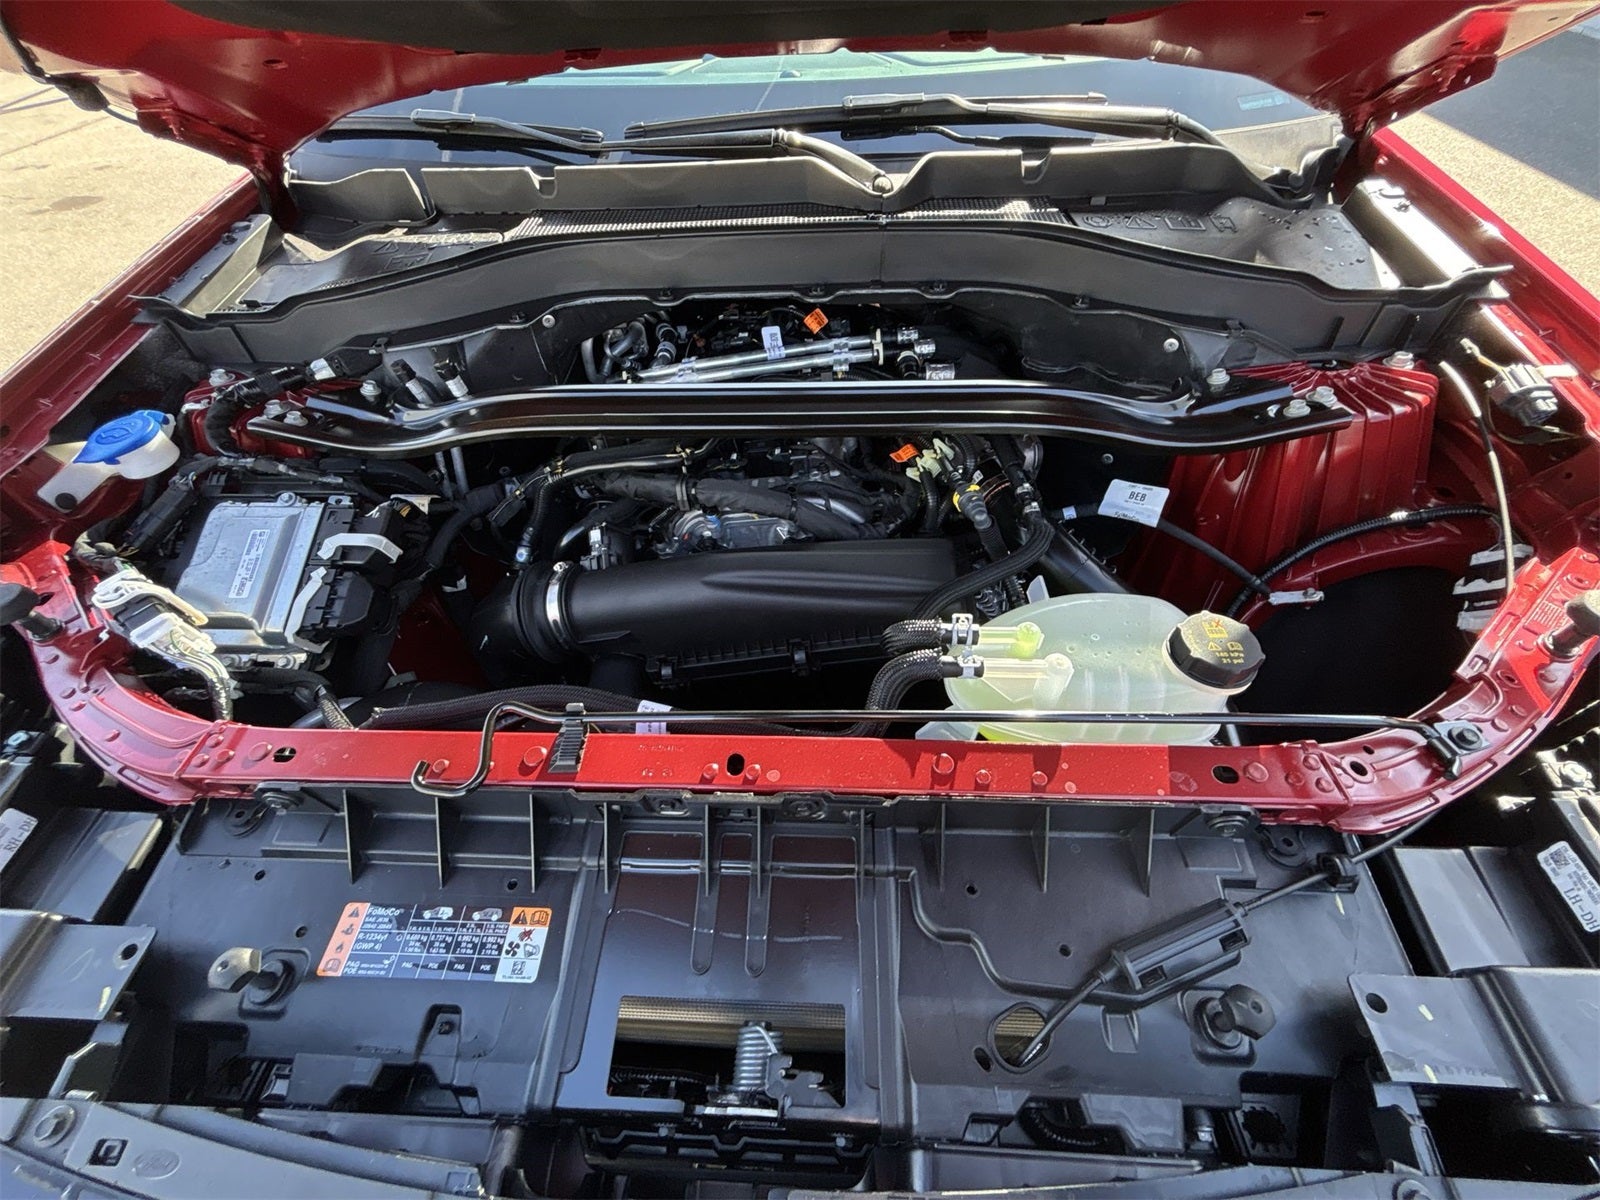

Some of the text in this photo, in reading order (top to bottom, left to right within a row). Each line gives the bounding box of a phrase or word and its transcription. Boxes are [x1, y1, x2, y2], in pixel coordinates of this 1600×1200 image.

[1128, 490, 1147, 502] BEB
[367, 907, 400, 916] FoMoCo
[358, 933, 388, 943] R-1234yf
[353, 942, 373, 951] (GWP
